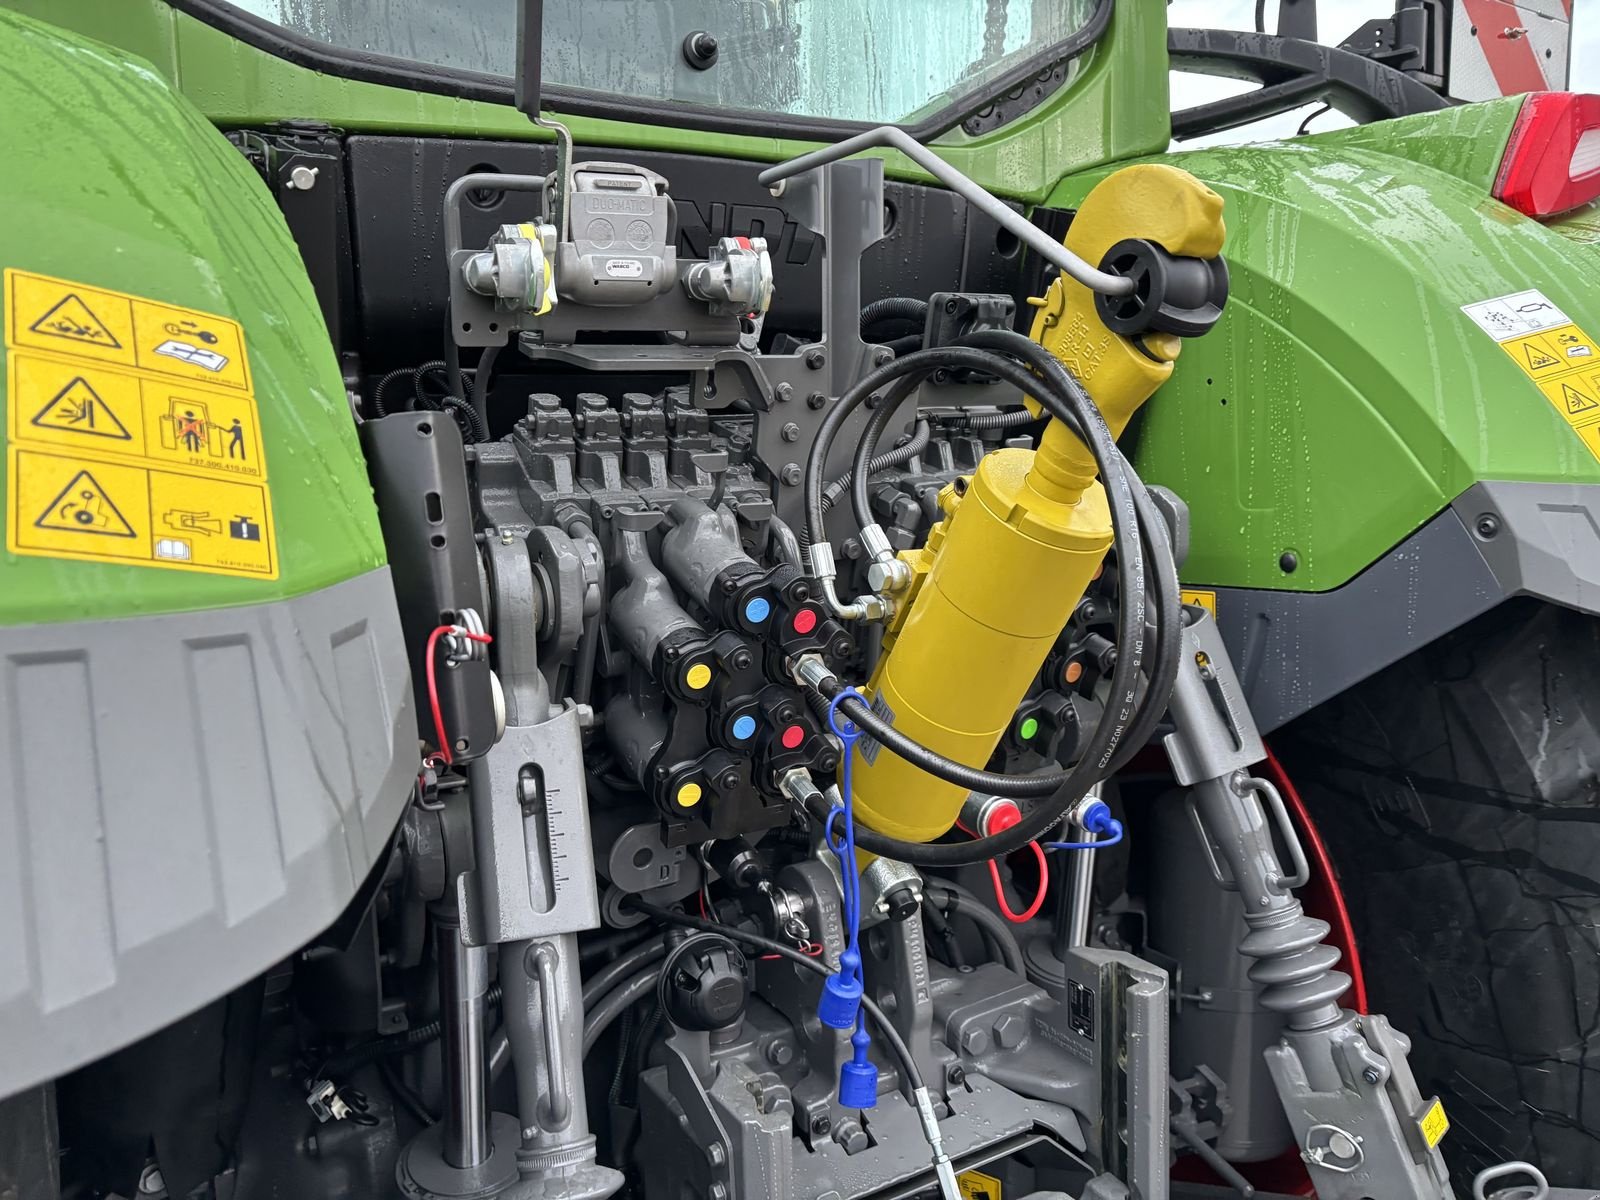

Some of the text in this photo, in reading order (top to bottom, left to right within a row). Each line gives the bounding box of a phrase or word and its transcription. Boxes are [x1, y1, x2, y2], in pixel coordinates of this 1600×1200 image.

[592, 197, 647, 212] DUO-MATIC
[1126, 499, 1135, 516] 100
[1135, 557, 1143, 571] EN
[1134, 640, 1144, 654] DN
[1120, 708, 1130, 721] 23
